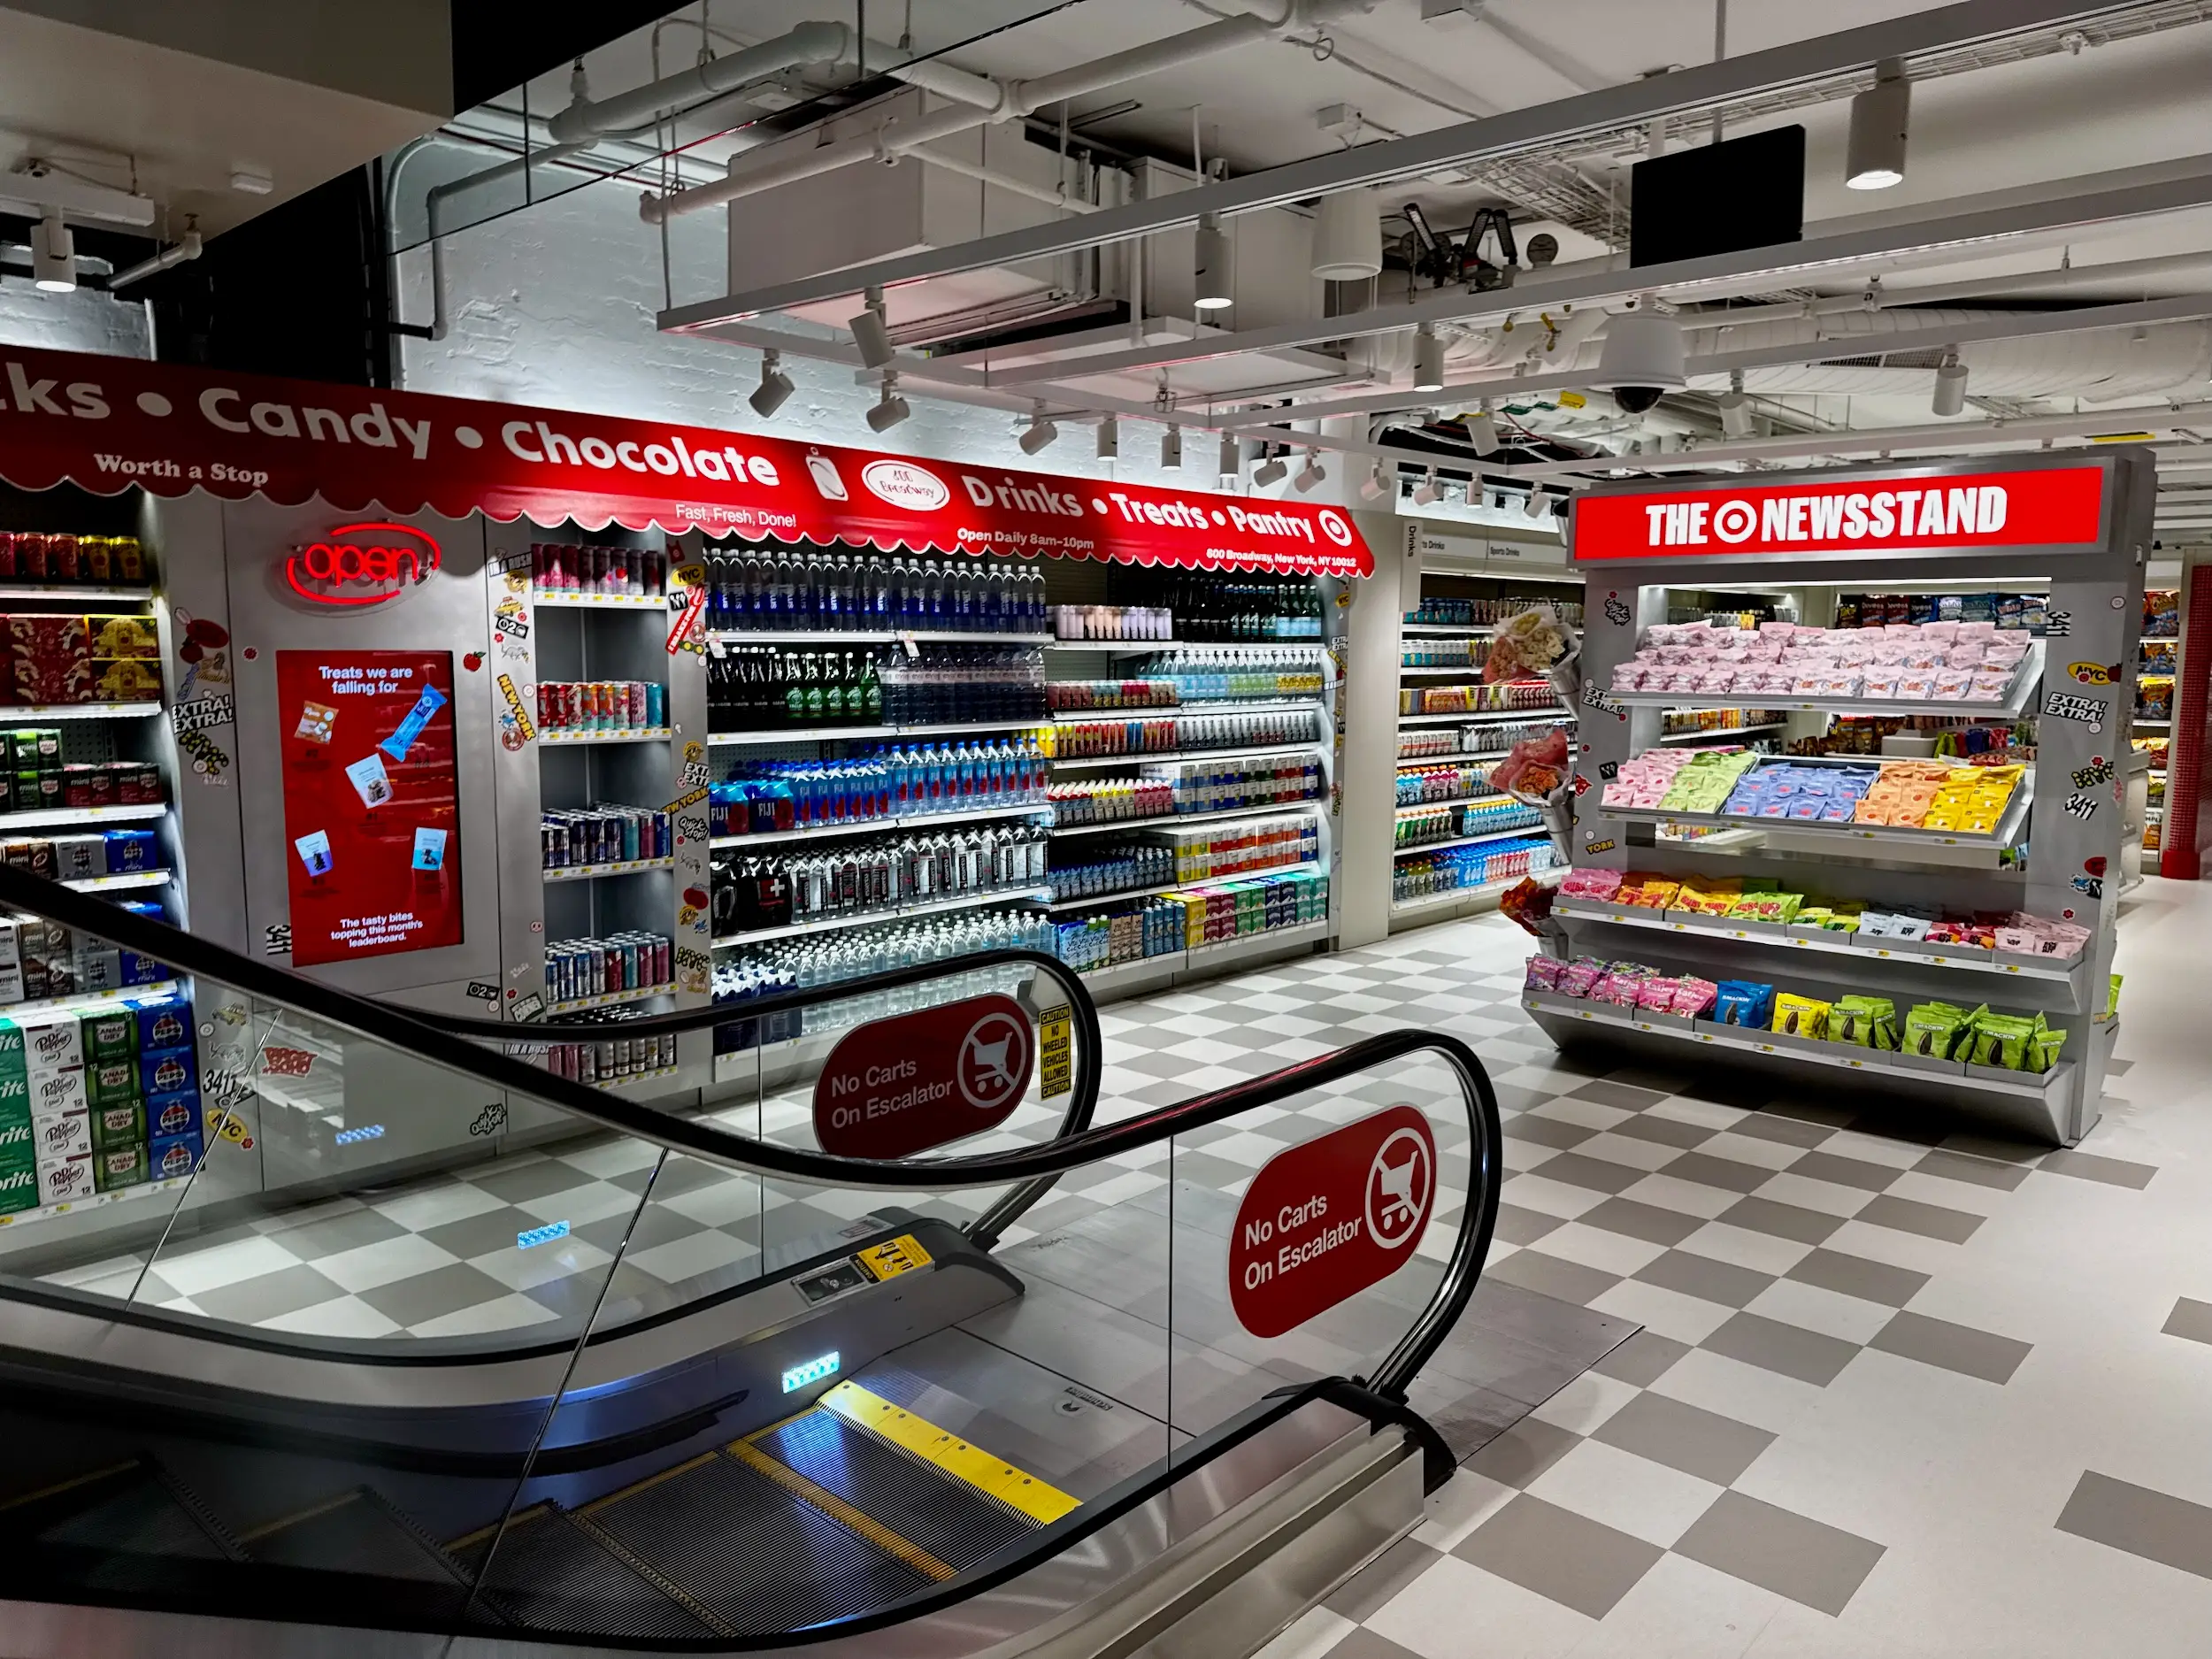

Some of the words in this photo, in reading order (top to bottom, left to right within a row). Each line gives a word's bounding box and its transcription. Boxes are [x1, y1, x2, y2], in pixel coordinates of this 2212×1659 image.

[0, 362, 111, 419] ks
[199, 388, 431, 459] Candy
[502, 421, 780, 486] Chocolate
[93, 453, 180, 477] Worth
[188, 465, 203, 479] a
[211, 464, 269, 487] Stop
[677, 504, 711, 522] Fast,
[714, 507, 756, 526] Fresh,
[757, 510, 796, 528] Done!
[962, 476, 1083, 518] Drinks
[1109, 493, 1209, 530] Treats
[1230, 505, 1314, 542] Pantry
[1646, 502, 1709, 546] THE
[1763, 486, 2008, 542] NEWSSTAND
[957, 527, 990, 544] Open
[992, 531, 1026, 546] Daily
[1408, 526, 1417, 557] Drinks
[1428, 541, 1445, 550] Drinks
[1207, 549, 1225, 560] 600
[1226, 550, 1273, 565] Broadway,
[1275, 554, 1294, 564] New
[1295, 555, 1317, 566] York,
[1318, 557, 1331, 565] NY
[1332, 557, 1356, 567] 10012
[1490, 547, 1505, 556] Sports
[1506, 548, 1520, 557] Drinks
[303, 541, 419, 588] open
[678, 568, 700, 583] NYC
[2047, 611, 2070, 636] 3411
[319, 665, 363, 680] Treats
[366, 669, 387, 680] we
[390, 668, 412, 679] are
[2075, 664, 2108, 680] NYC
[332, 680, 375, 695] falling
[379, 681, 398, 694] for
[497, 673, 519, 706] NEW
[1584, 696, 1624, 716] EXTRA!
[2048, 693, 2108, 713] EXTRA!
[173, 709, 233, 733] EXTRA!
[512, 703, 537, 741] YORK
[2045, 703, 2105, 723] EXTRA!
[679, 787, 709, 807] YORK
[711, 806, 728, 821] FIJI
[758, 802, 775, 817] FIJI
[2063, 792, 2099, 821] 3411
[680, 818, 706, 832] Quick
[1586, 839, 1615, 855] YORK
[341, 918, 360, 928] The
[362, 915, 387, 927] tasty
[388, 911, 413, 924] bites
[331, 926, 367, 941] topping
[368, 923, 386, 935] this
[388, 919, 423, 934] month's
[349, 933, 406, 949] leaderboard.
[1613, 975, 1639, 989] Katjes
[1645, 981, 1674, 994] Katjes
[1677, 988, 1705, 1001] Katjes
[1041, 1007, 1069, 1024] CAUTION
[104, 1032, 120, 1041] DRY
[155, 1025, 181, 1036] PEPSI
[1051, 1025, 1059, 1038] NO
[35, 1034, 70, 1053] Pepper
[1043, 1036, 1068, 1054] WHEELED
[89, 1063, 98, 1071] 12
[1042, 1050, 1068, 1069] VEHICLES
[107, 1076, 124, 1086] DRY
[157, 1070, 184, 1081] PEPSI
[204, 1069, 236, 1094] 3411
[832, 1072, 859, 1097] No
[865, 1059, 917, 1088] Carts
[1043, 1065, 1068, 1082] ALLOWED
[41, 1079, 73, 1097] Pepper
[1042, 1079, 1070, 1098] CAUTION
[832, 1107, 860, 1129] On
[866, 1079, 954, 1120] Escalator
[111, 1119, 127, 1129] DRY
[162, 1113, 188, 1124] PEPSI
[211, 1113, 242, 1137] NYC
[46, 1124, 78, 1142] Pepper
[114, 1163, 131, 1172] DRY
[164, 1156, 190, 1168] PEPSI
[50, 1169, 81, 1187] Pepper
[1245, 1218, 1272, 1250] No
[1278, 1194, 1327, 1233] Carts
[1245, 1261, 1272, 1290] On
[1278, 1217, 1363, 1275] Escalator
